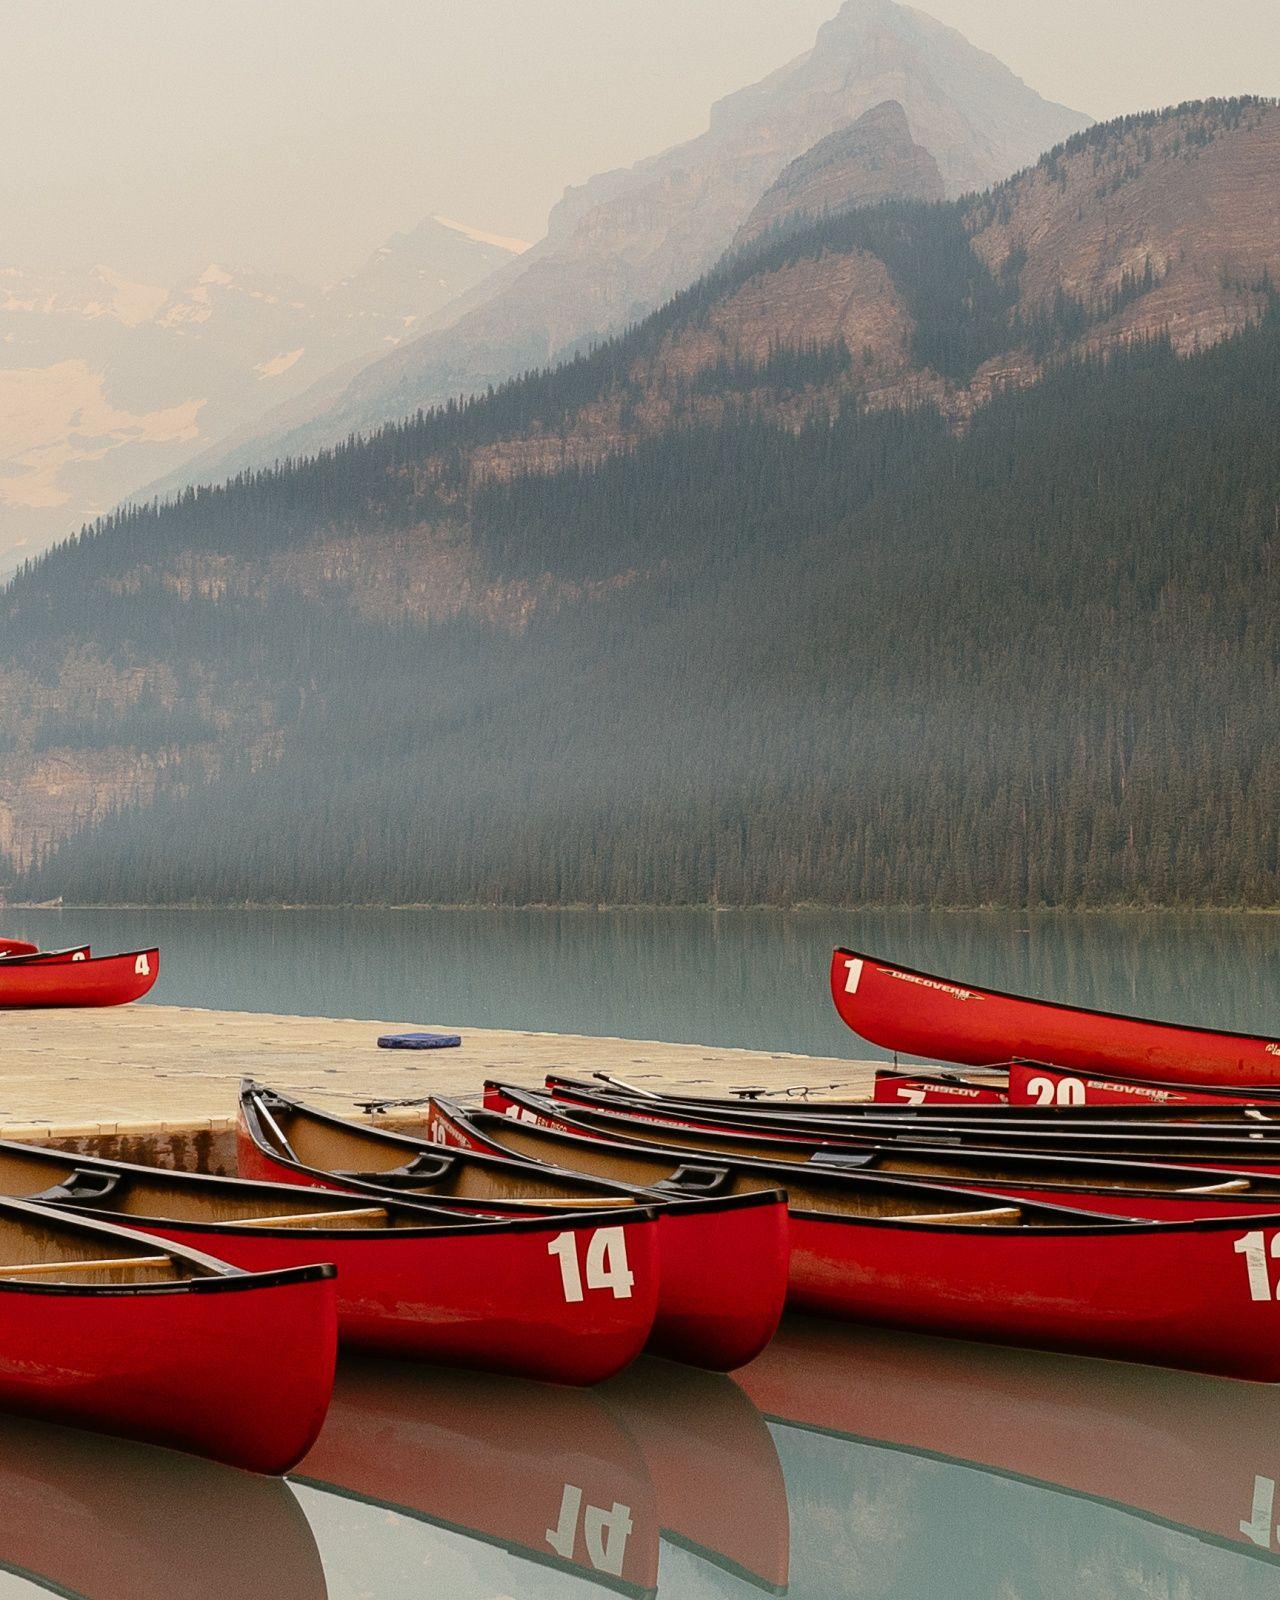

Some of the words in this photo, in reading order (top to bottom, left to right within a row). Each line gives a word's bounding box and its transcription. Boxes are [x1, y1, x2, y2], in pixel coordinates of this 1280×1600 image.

[134, 953, 151, 976] 4
[844, 958, 864, 995] 1
[1026, 1077, 1086, 1105] 20
[547, 1226, 635, 1303] 14
